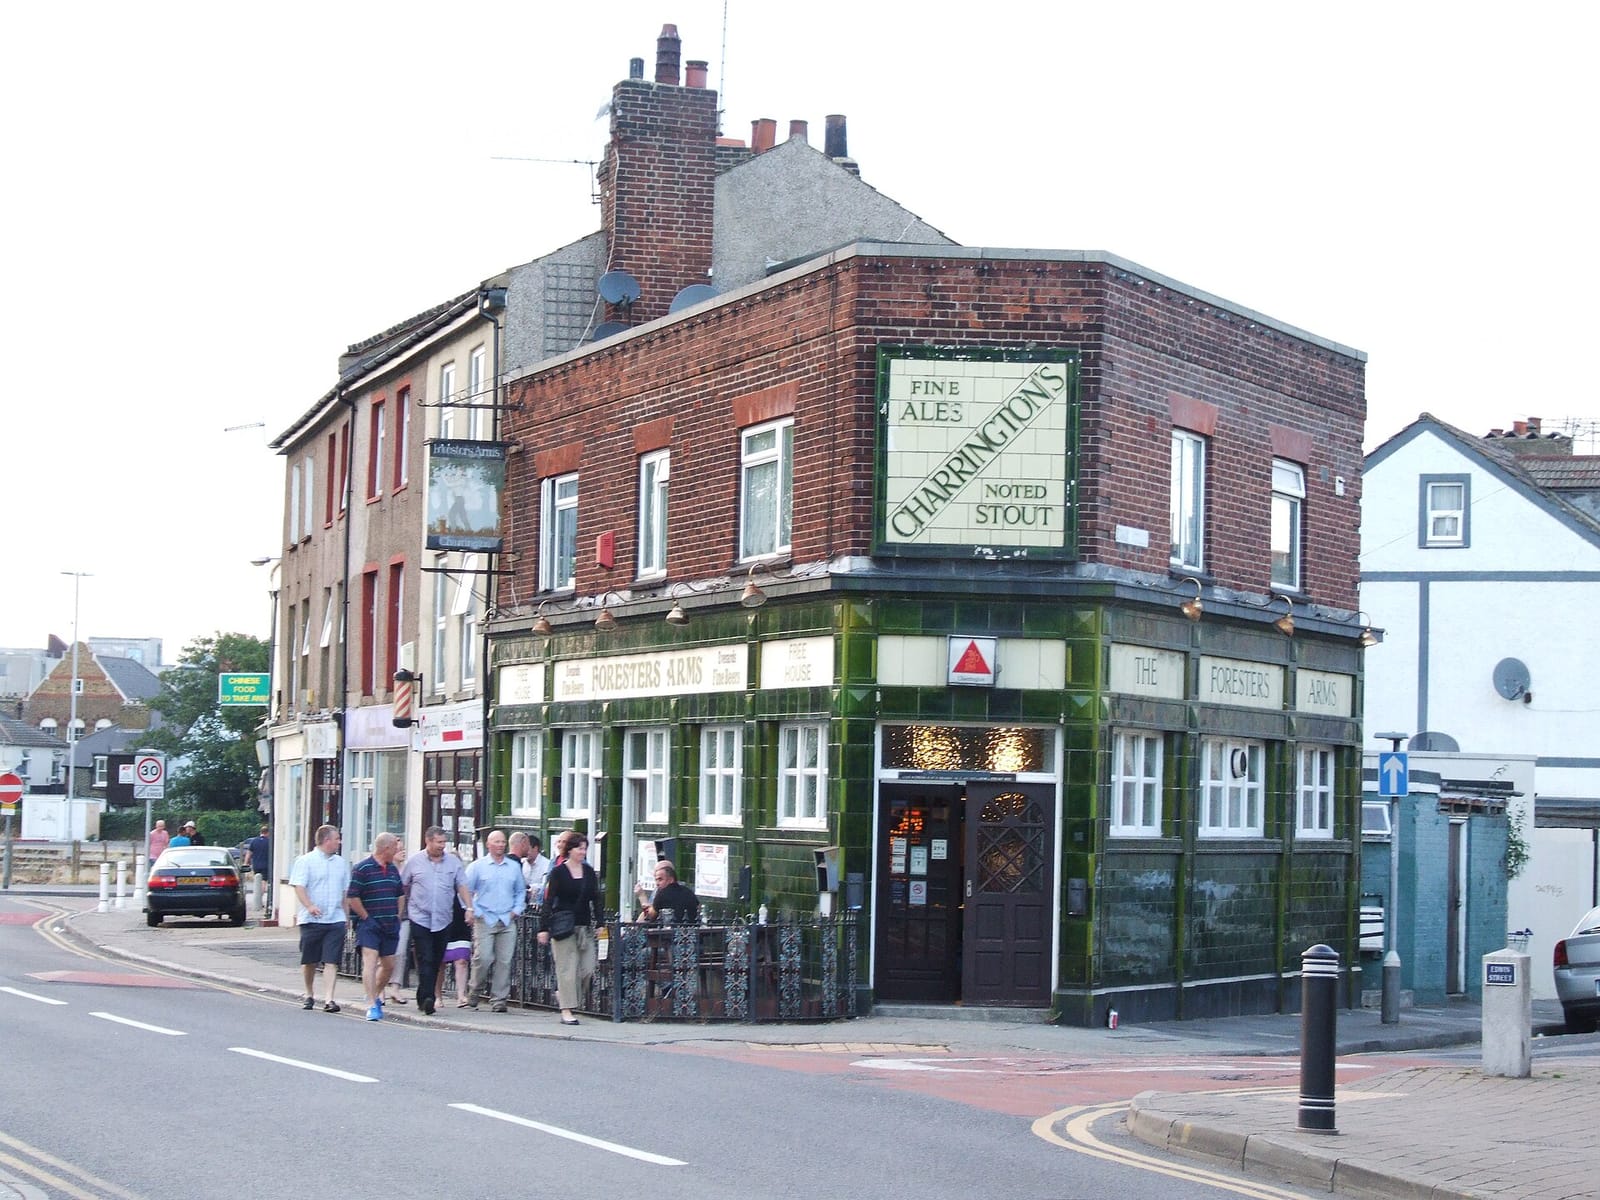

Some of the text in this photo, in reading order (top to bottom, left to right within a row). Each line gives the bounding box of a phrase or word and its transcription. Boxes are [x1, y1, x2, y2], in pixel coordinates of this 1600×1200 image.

[911, 380, 961, 396] FINE
[900, 402, 964, 422] ALES
[891, 366, 1065, 538] CHARRINGTON'S
[984, 484, 1048, 499] NOTED
[975, 504, 1054, 526] STOUT
[788, 641, 808, 660] FREE
[228, 677, 261, 685] CHINESE
[591, 655, 704, 691] FORESTERS ARMS
[784, 663, 812, 682] HOUSE
[1135, 656, 1337, 707] THE FORESTERS ARMS
[141, 765, 159, 776] 30
